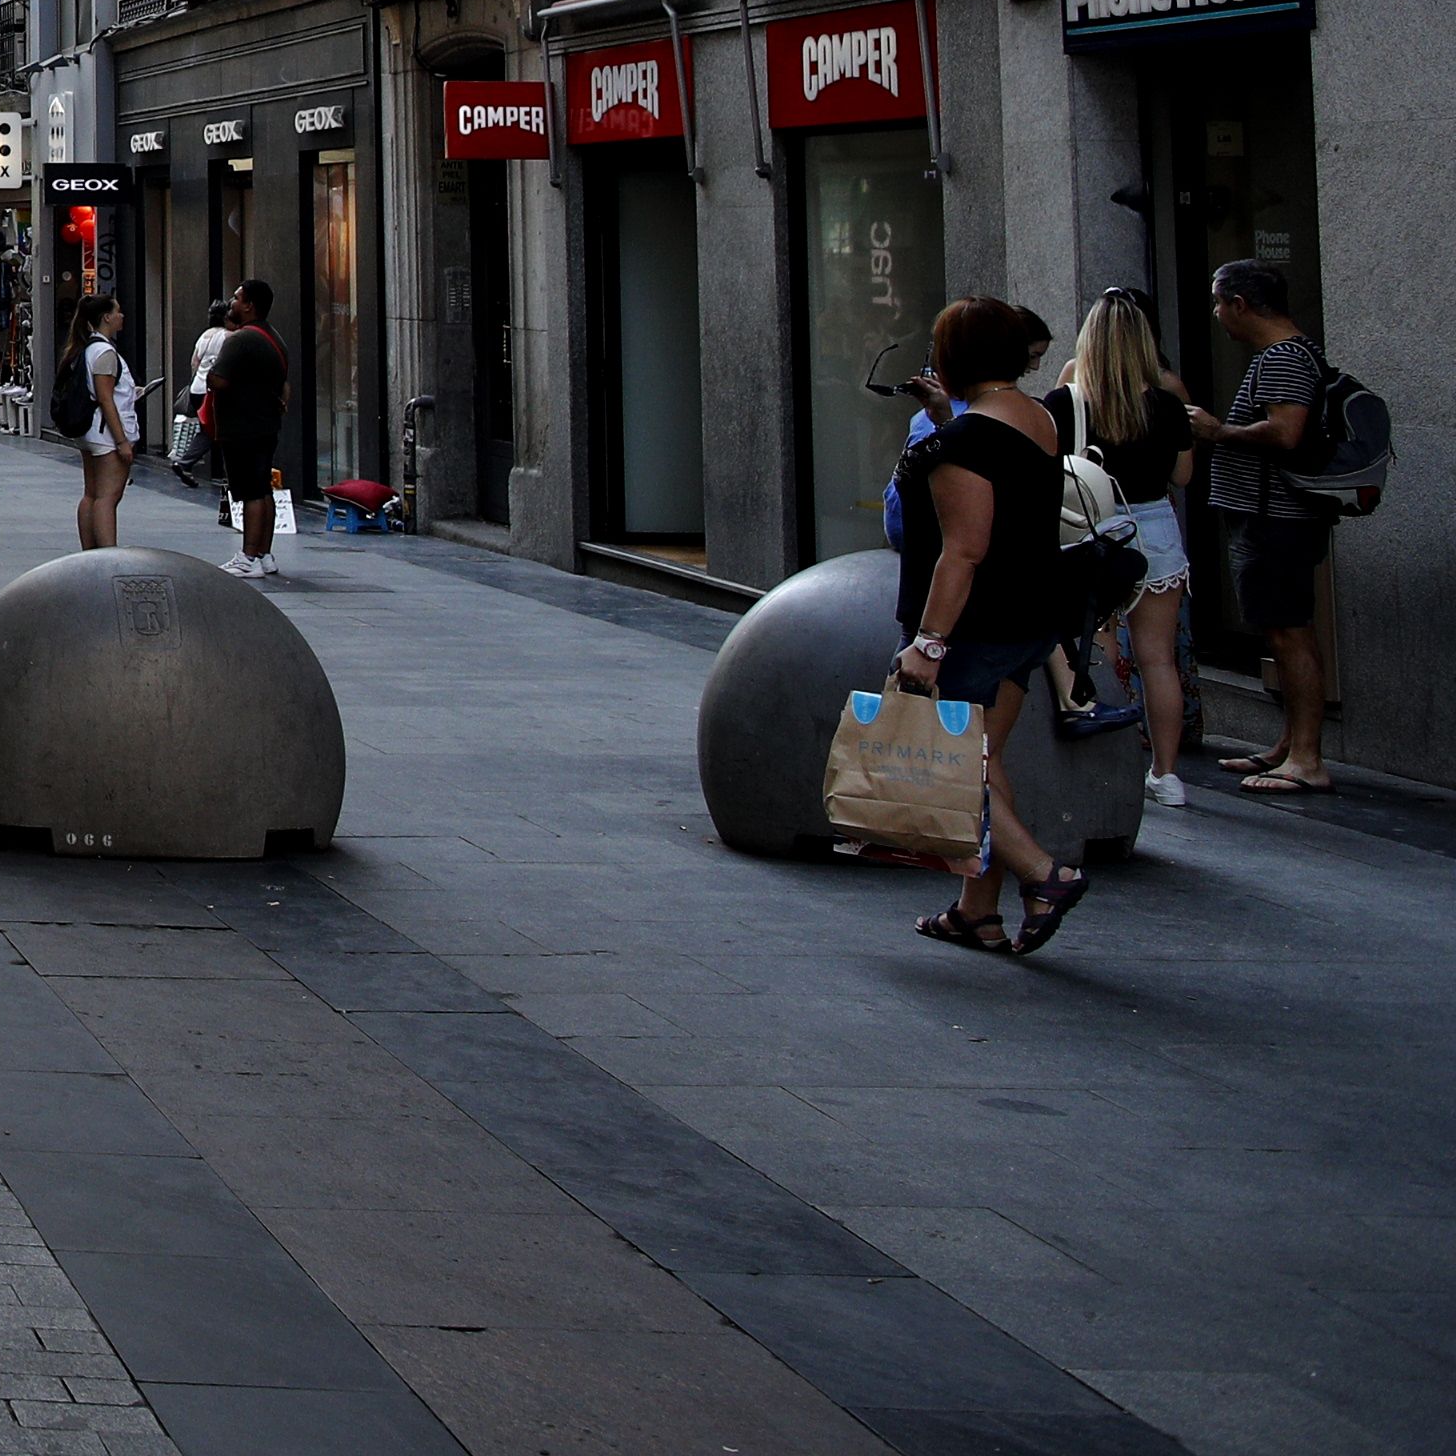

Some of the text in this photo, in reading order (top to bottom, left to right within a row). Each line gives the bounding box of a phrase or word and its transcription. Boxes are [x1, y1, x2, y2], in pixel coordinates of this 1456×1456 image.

[802, 26, 899, 101] CAMPER
[591, 59, 659, 123] CAMPER
[204, 120, 244, 145] GEOX
[295, 106, 343, 134] GEOX
[459, 106, 544, 135] CAMPER
[130, 131, 164, 154] GEOX
[52, 179, 119, 191] GEOX
[1254, 230, 1290, 245] Phone
[1255, 244, 1290, 260] House
[858, 740, 961, 767] PRIMARK
